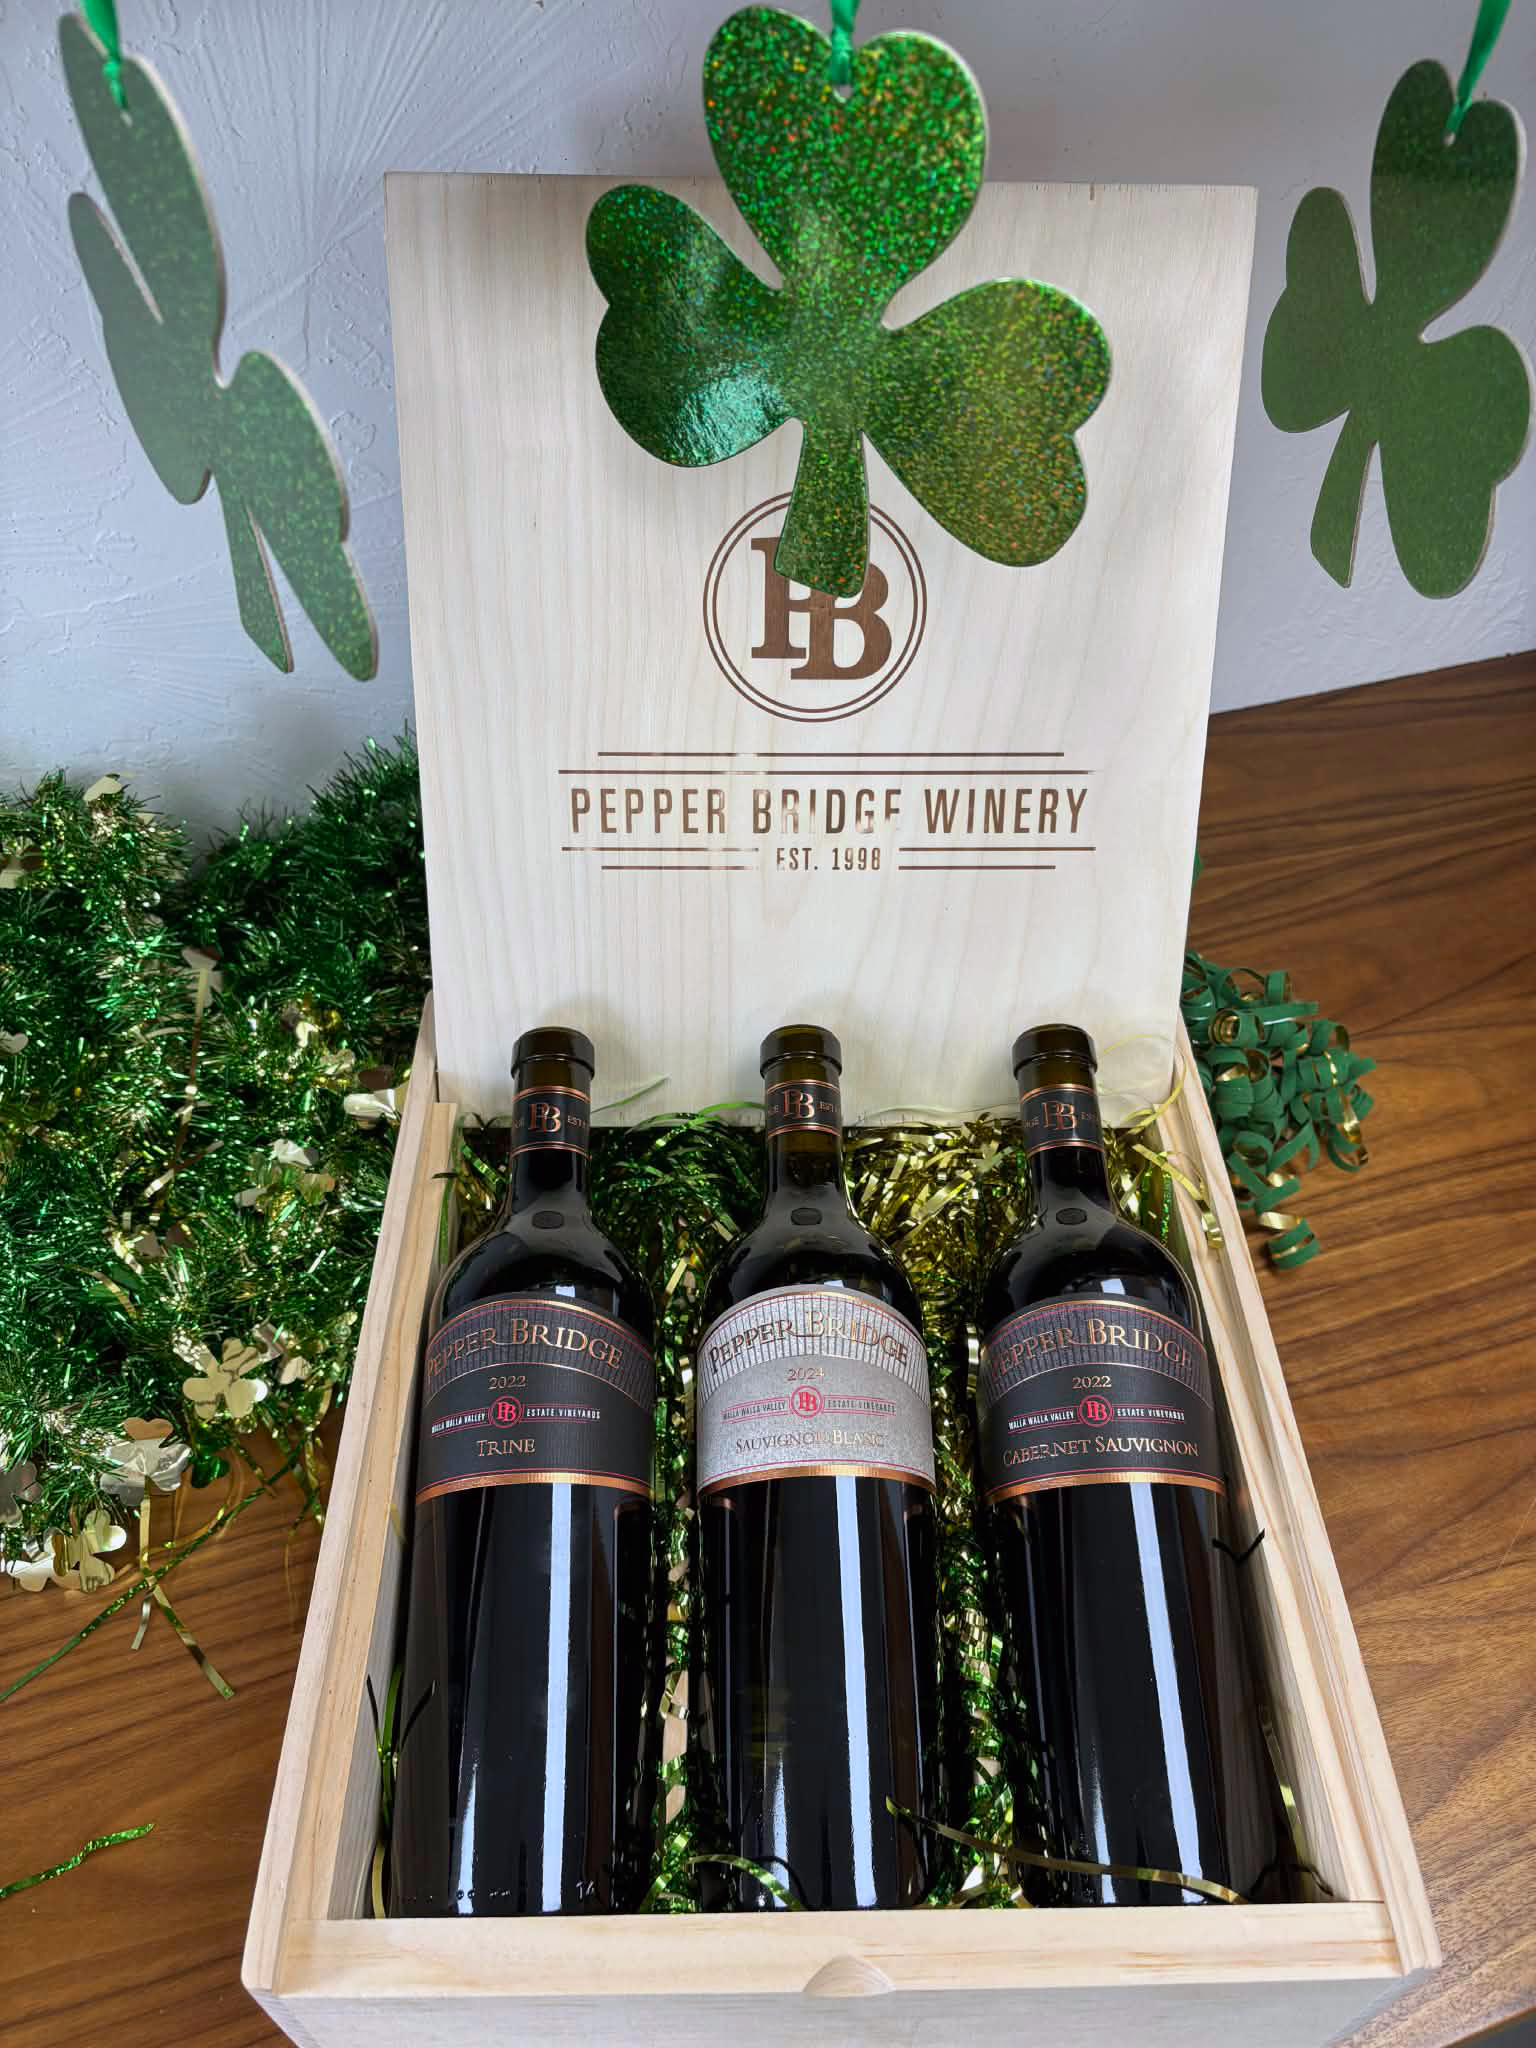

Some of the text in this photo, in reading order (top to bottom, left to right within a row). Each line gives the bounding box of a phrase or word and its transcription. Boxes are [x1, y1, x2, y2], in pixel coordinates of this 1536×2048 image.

[570, 788, 1088, 834] PEPPER BRIDGE WINERY
[776, 847, 882, 871] EST. 1998
[511, 1318, 624, 1369] BRIDGE
[708, 1310, 909, 1374] PEPPER BRIDGE
[1087, 1318, 1194, 1369] BRIDGE
[488, 1375, 528, 1391] 2022
[1072, 1375, 1112, 1390] 2022
[1050, 1410, 1075, 1422] VALLEY
[1117, 1407, 1145, 1417] ESTATE
[476, 1438, 536, 1457] TRINE
[1003, 1436, 1200, 1467] CABERNET SAUVIGNON
